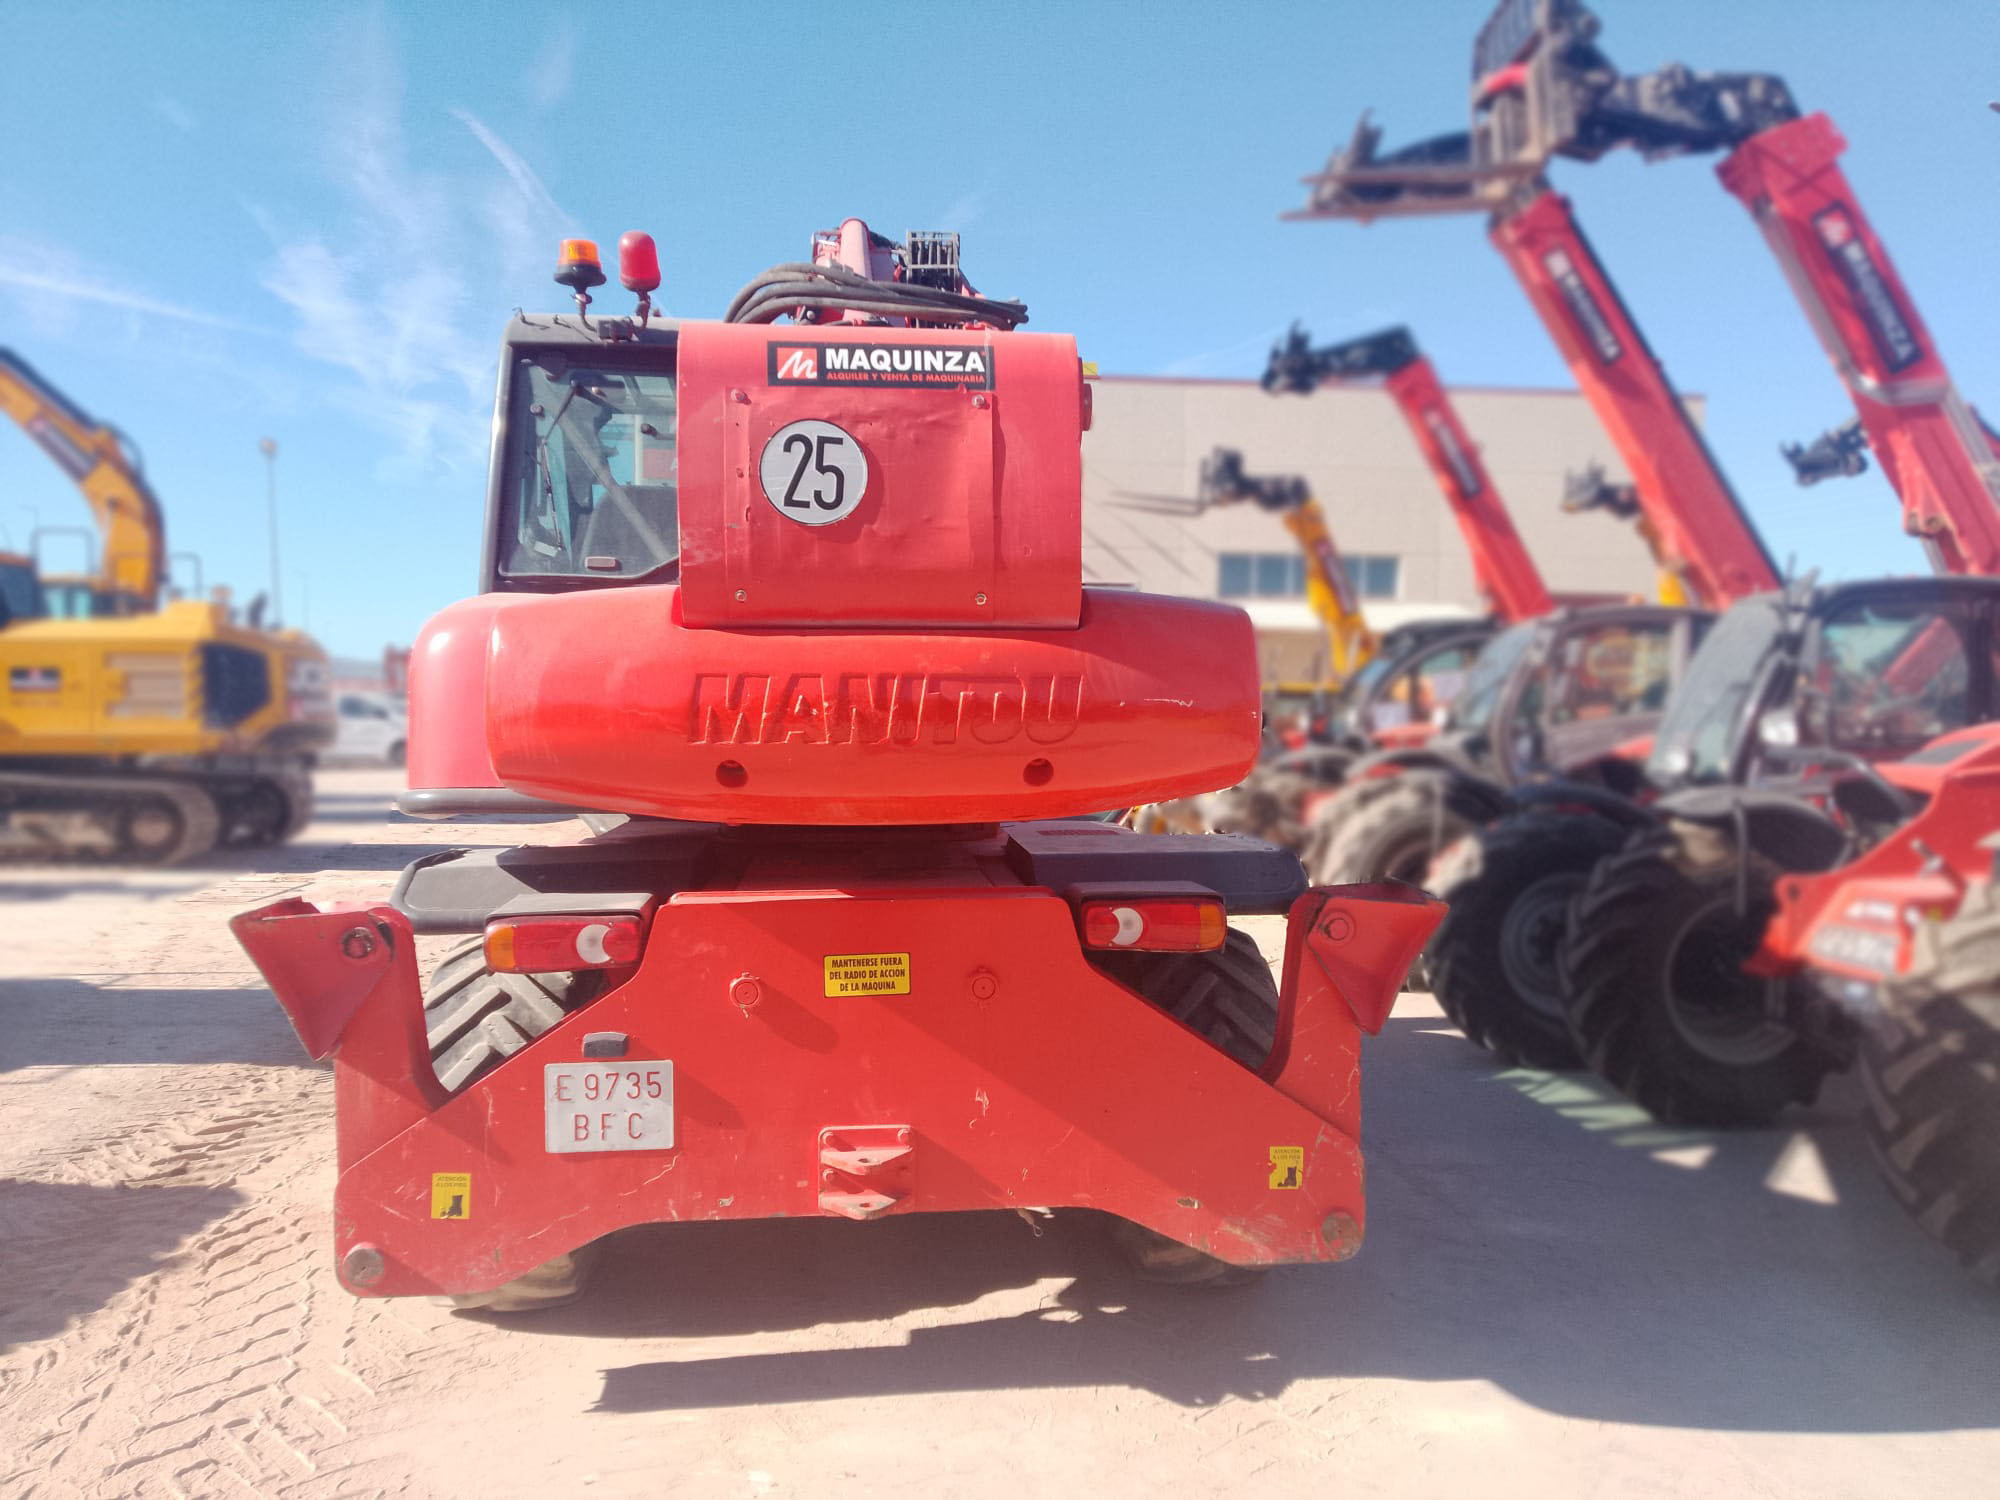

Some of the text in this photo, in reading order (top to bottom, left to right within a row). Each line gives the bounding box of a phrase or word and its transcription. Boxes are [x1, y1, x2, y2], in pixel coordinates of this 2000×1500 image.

[825, 348, 985, 373] MAQUINZA
[826, 372, 985, 383] ALQUILER Y VENTA DE MAQUINARIA
[783, 433, 845, 511] 25
[687, 672, 1084, 746] MANITOU
[831, 957, 903, 968] MANTENERSE FUERA
[829, 971, 842, 980] DEL
[844, 970, 867, 979] RADIO
[869, 969, 878, 978] DE
[840, 981, 896, 992] DE LA MAQUINA
[555, 1071, 662, 1101] E 9735
